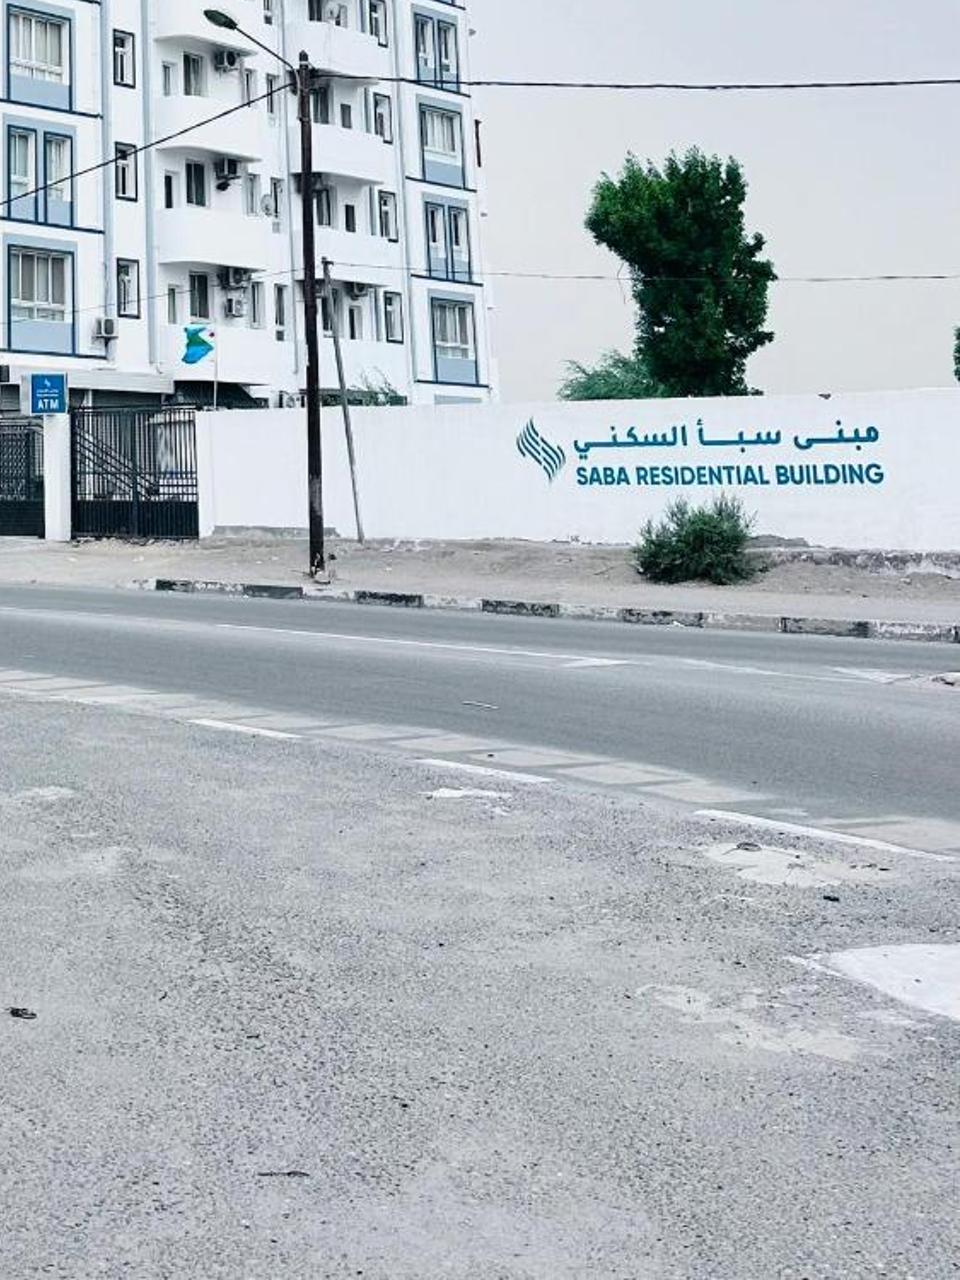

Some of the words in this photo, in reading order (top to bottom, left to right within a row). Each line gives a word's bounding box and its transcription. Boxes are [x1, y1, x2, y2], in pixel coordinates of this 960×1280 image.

[38, 399, 59, 409] ATM
[573, 424, 688, 460] السكني
[696, 418, 781, 453] سبأ
[793, 420, 879, 451] مبنى
[576, 466, 631, 485] SABA
[635, 465, 770, 485] RESIDENTIAL
[775, 463, 884, 485] BUILDING
